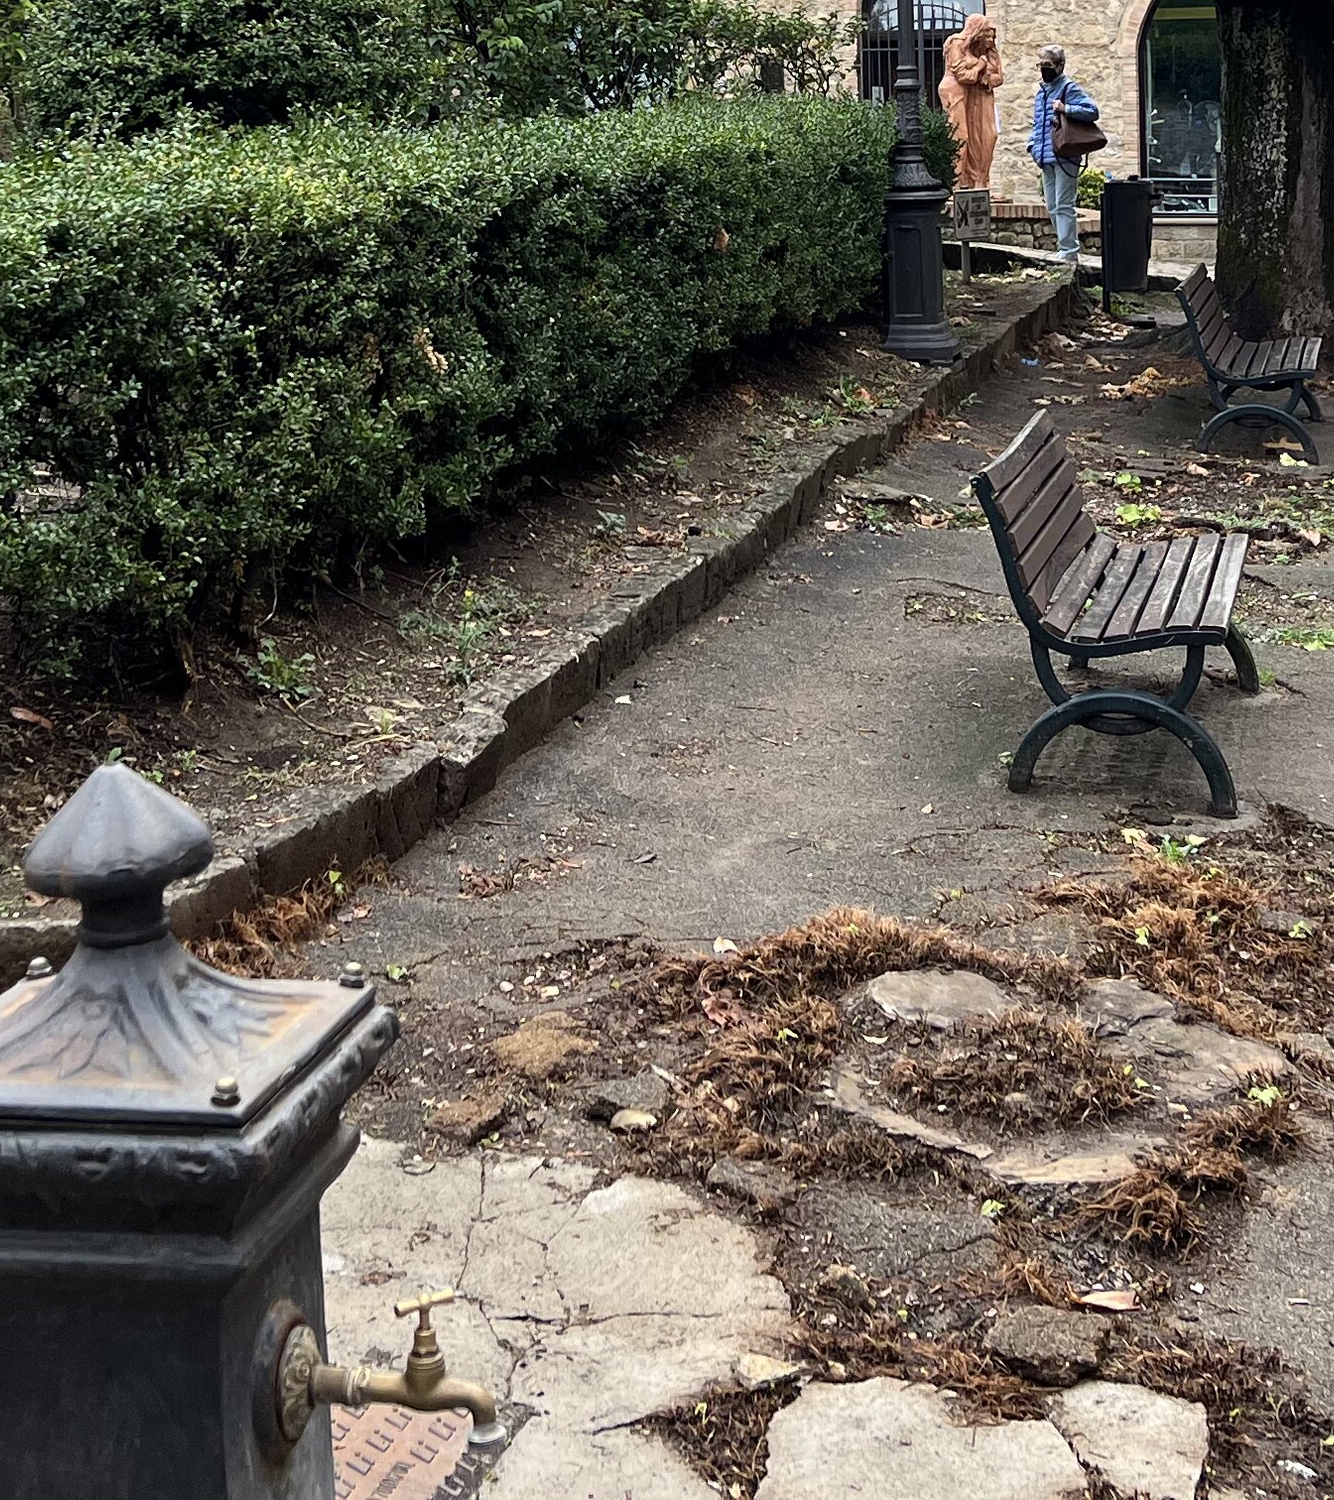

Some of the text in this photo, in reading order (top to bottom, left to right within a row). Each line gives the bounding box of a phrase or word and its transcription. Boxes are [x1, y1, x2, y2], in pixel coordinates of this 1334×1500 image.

[346, 1451, 375, 1476] Li
[365, 1428, 394, 1453] Li
[384, 1406, 412, 1431] Li
[409, 1440, 439, 1464] Li
[428, 1417, 456, 1441] Li
